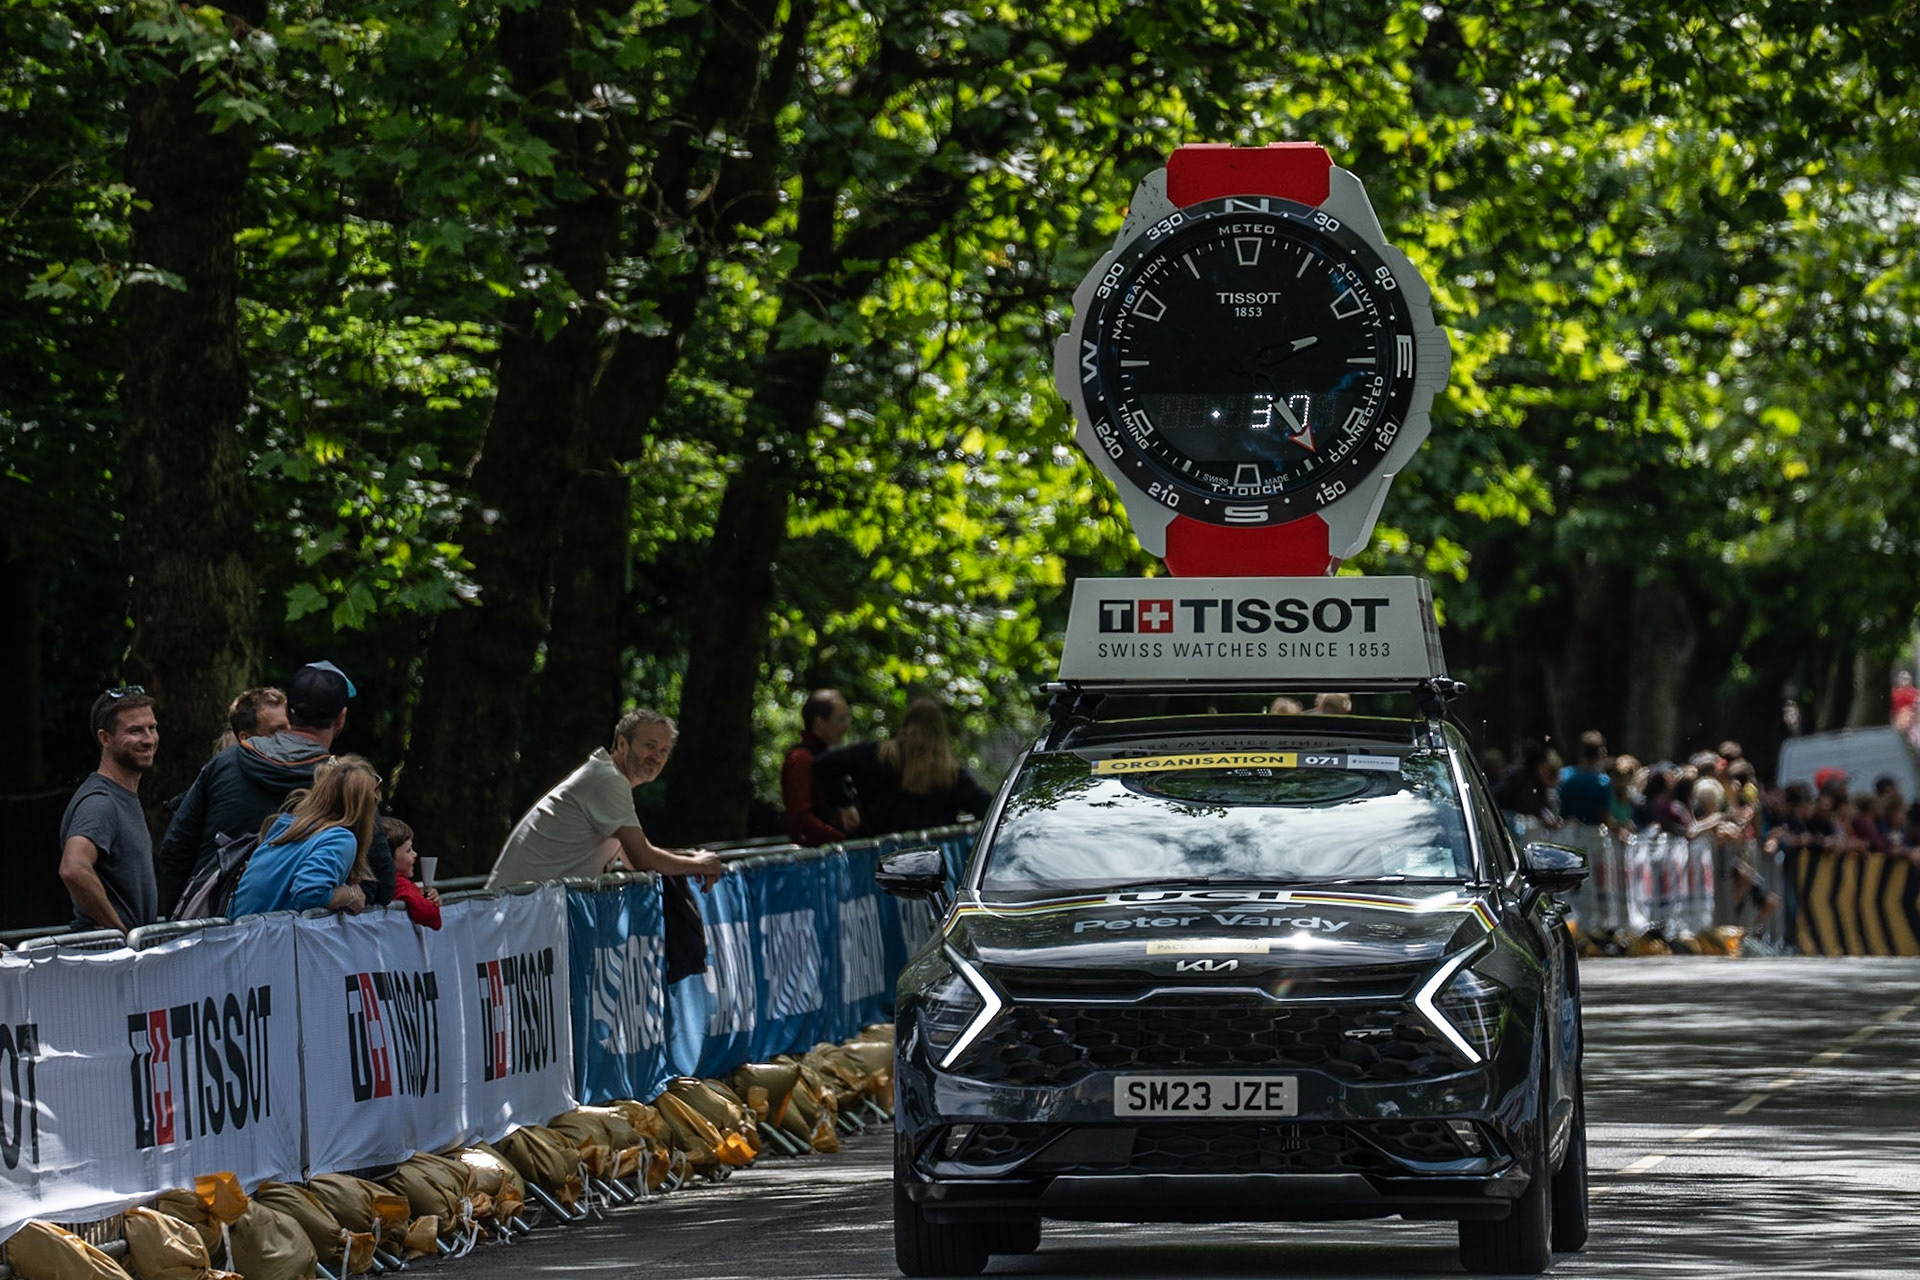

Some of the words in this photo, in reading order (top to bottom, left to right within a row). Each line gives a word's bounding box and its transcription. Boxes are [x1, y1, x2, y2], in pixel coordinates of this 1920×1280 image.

[1225, 199, 1269, 213] N
[1147, 213, 1183, 240] 330
[1219, 224, 1275, 235] METEO
[1314, 212, 1340, 232] 30
[1097, 263, 1124, 299] 300
[1375, 266, 1396, 291] 60
[1112, 255, 1167, 340] NAVIGATION
[1216, 292, 1281, 304] TISSOT
[1337, 262, 1382, 328] ACTIVITY
[1235, 307, 1262, 317] 1853
[1082, 339, 1097, 384] W
[1396, 335, 1413, 378] E
[1119, 404, 1149, 450] TIMING
[1330, 376, 1384, 463] CONNECTED
[1096, 423, 1124, 459] 240
[1374, 421, 1398, 452] 120
[1203, 472, 1229, 486] SWISS
[1265, 474, 1289, 486] MADE
[1212, 483, 1283, 496] T-TOUCH
[1315, 480, 1346, 505] 150
[1148, 482, 1180, 507] 210
[1224, 505, 1269, 522] S
[1180, 598, 1389, 634] TISSOT
[1098, 642, 1163, 658] SWISS
[1173, 642, 1267, 658] WATCHES
[1278, 642, 1337, 657] SINCE
[1349, 642, 1391, 657] 1853
[1111, 755, 1285, 770] ORGANISATION
[1305, 755, 1339, 765] 071
[1074, 916, 1200, 933] Peter
[1212, 914, 1349, 932] Vardy
[501, 947, 556, 1075] TISSOT
[371, 970, 440, 1098] TISSOT
[170, 985, 271, 1140] TISSOT
[1128, 1082, 1211, 1110] SM23
[1222, 1082, 1283, 1110] JZE
